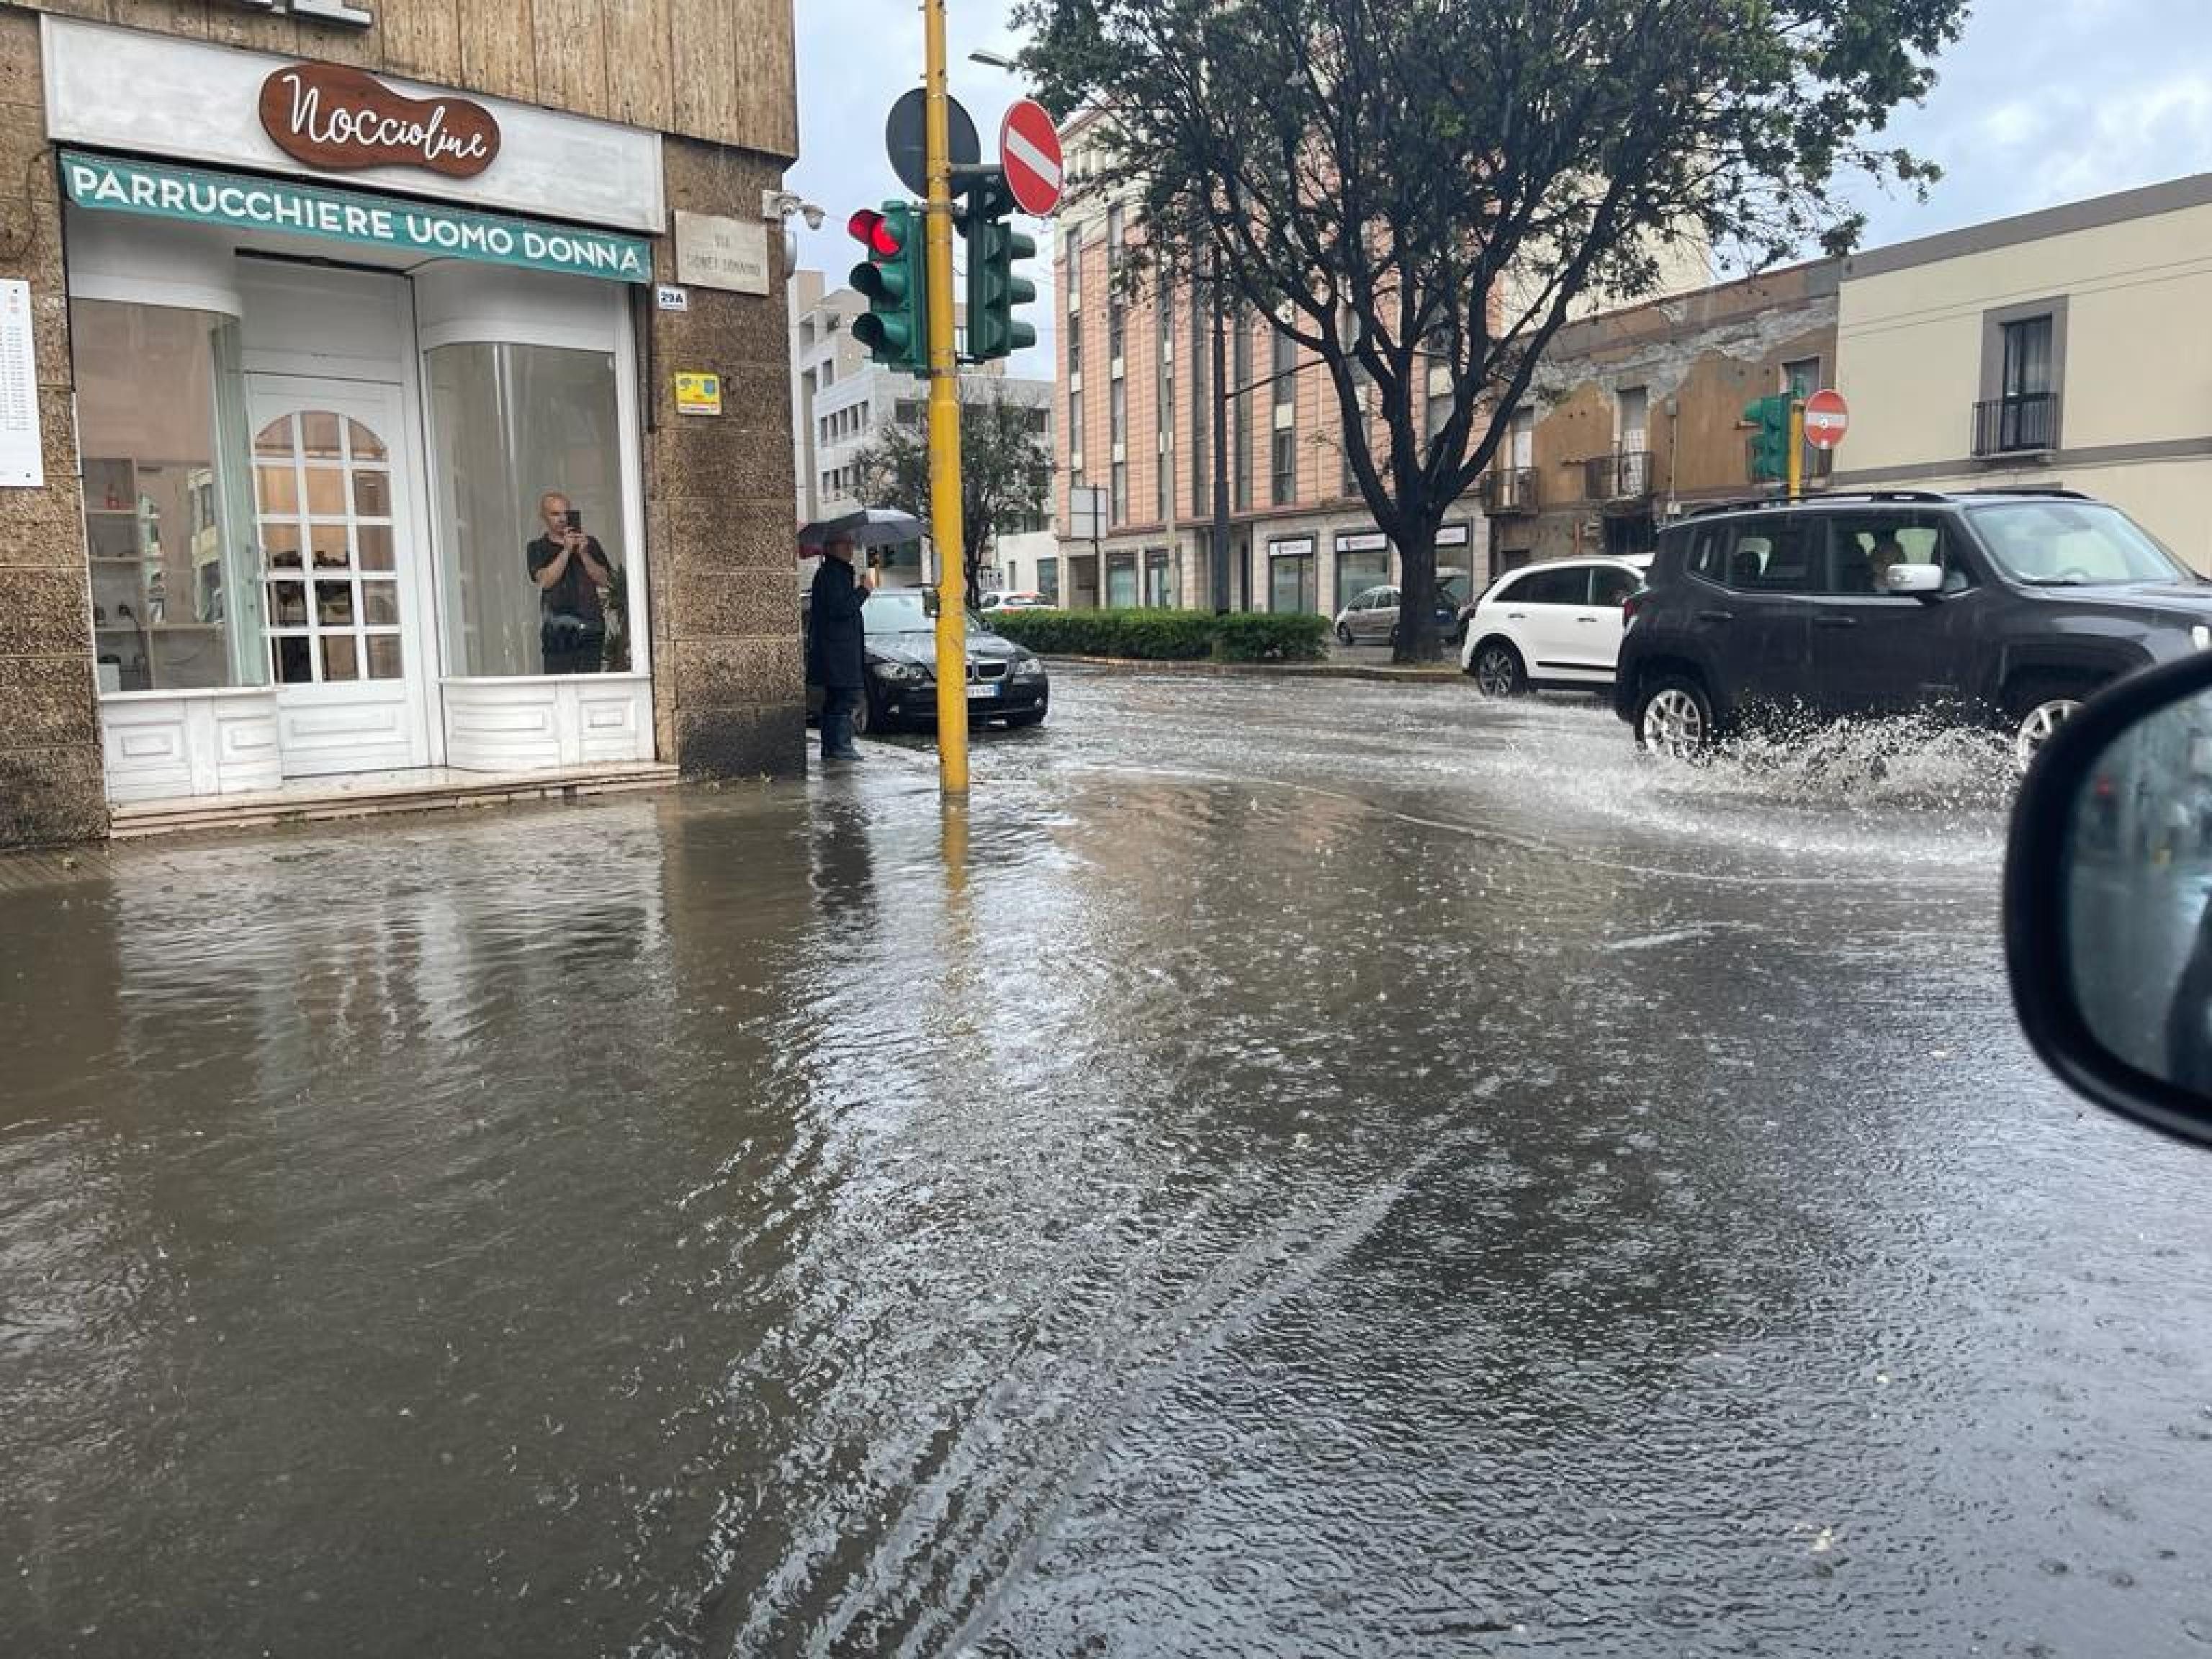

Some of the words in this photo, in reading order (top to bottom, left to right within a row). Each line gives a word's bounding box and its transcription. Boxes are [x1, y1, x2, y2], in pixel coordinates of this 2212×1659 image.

[282, 74, 487, 158] Noccioline
[72, 166, 395, 239] PARRUCCHIERE
[408, 215, 513, 253] UOMO
[523, 233, 642, 273] DONNA
